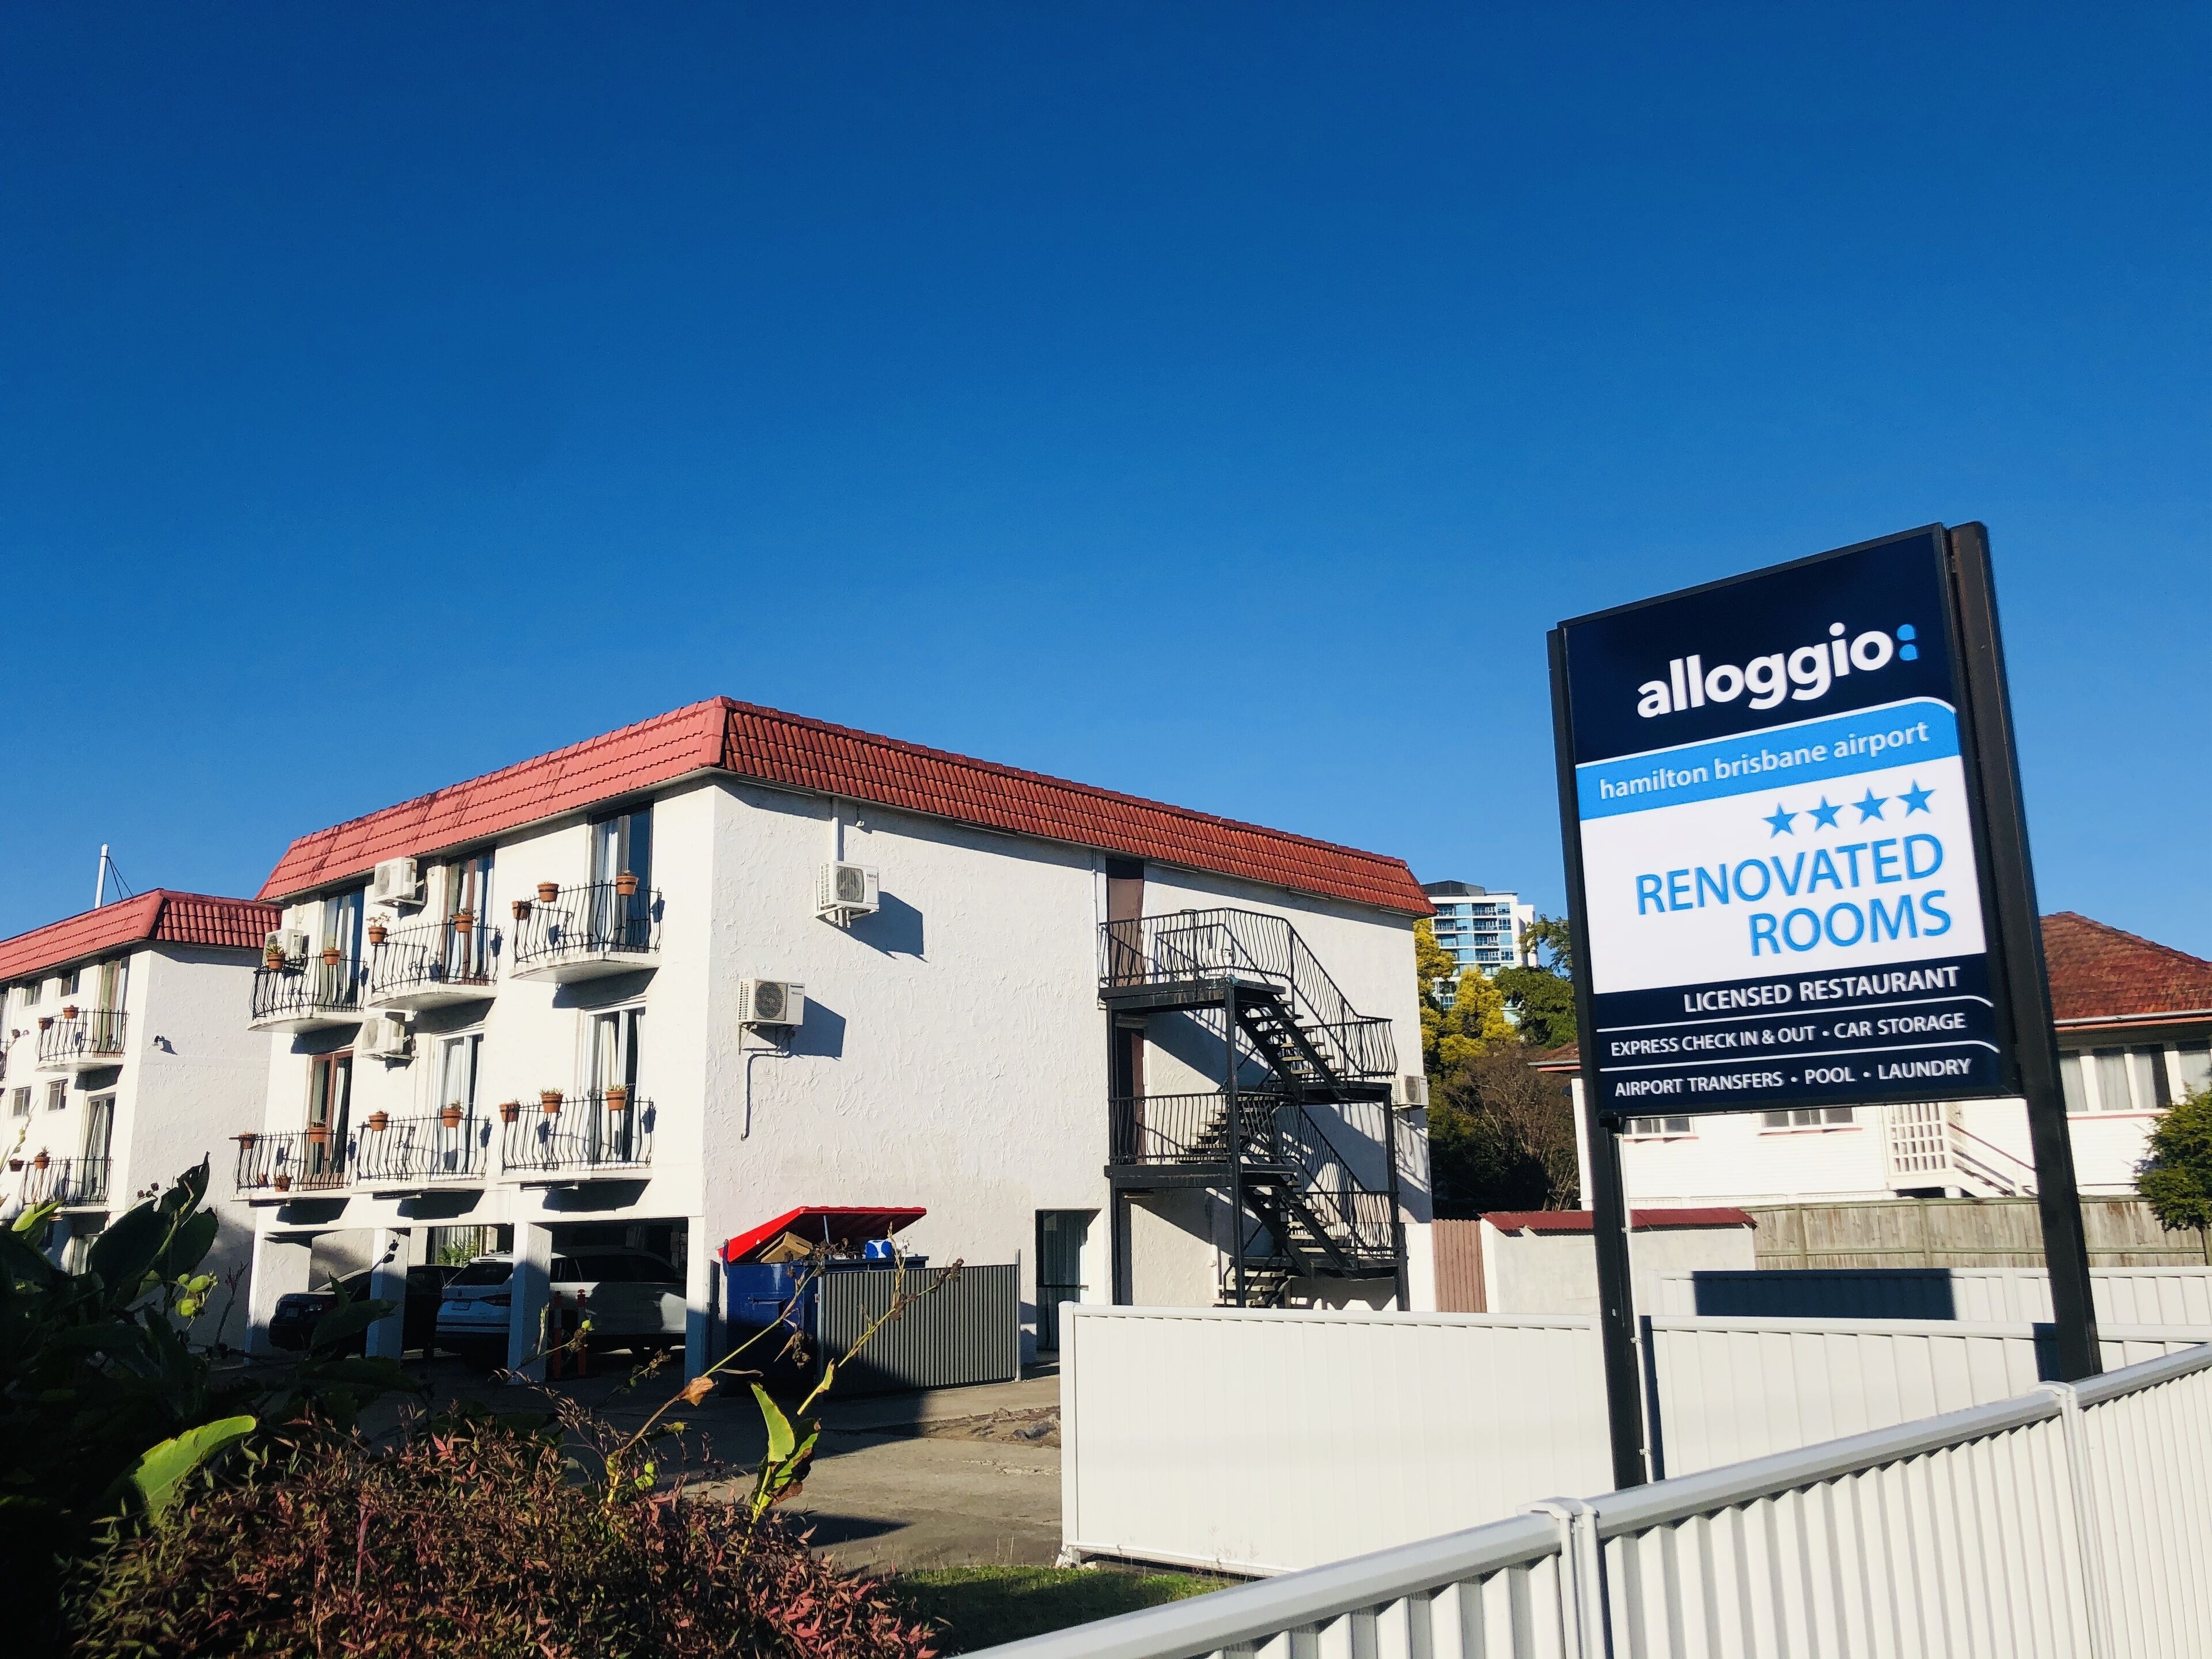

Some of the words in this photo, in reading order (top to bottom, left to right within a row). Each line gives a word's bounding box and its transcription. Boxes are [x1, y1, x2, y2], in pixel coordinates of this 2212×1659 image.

[1600, 767, 1709, 800] hamilton
[1714, 744, 1827, 779] brisbane
[1834, 722, 1929, 758] airport
[1635, 833, 1945, 916] RENOVATED
[1748, 889, 1953, 957] ROOMS
[1684, 984, 1793, 1013] LICENSED
[1799, 965, 1960, 1002] RESTAURANT
[1611, 1037, 1680, 1056] EXPRESS
[1681, 1034, 1738, 1051] CHECK
[1740, 1031, 1759, 1046] IN
[1761, 1029, 1776, 1044] &
[1778, 1025, 1817, 1044] OUT
[1834, 1021, 1873, 1039] CAR
[1877, 1012, 1967, 1035] STORAGE
[1615, 1078, 1684, 1097] AIRPORT
[1687, 1071, 1784, 1092] TRANSFERS
[1805, 1067, 1855, 1085] POOL
[1878, 1058, 1972, 1080] LAUNDRY
